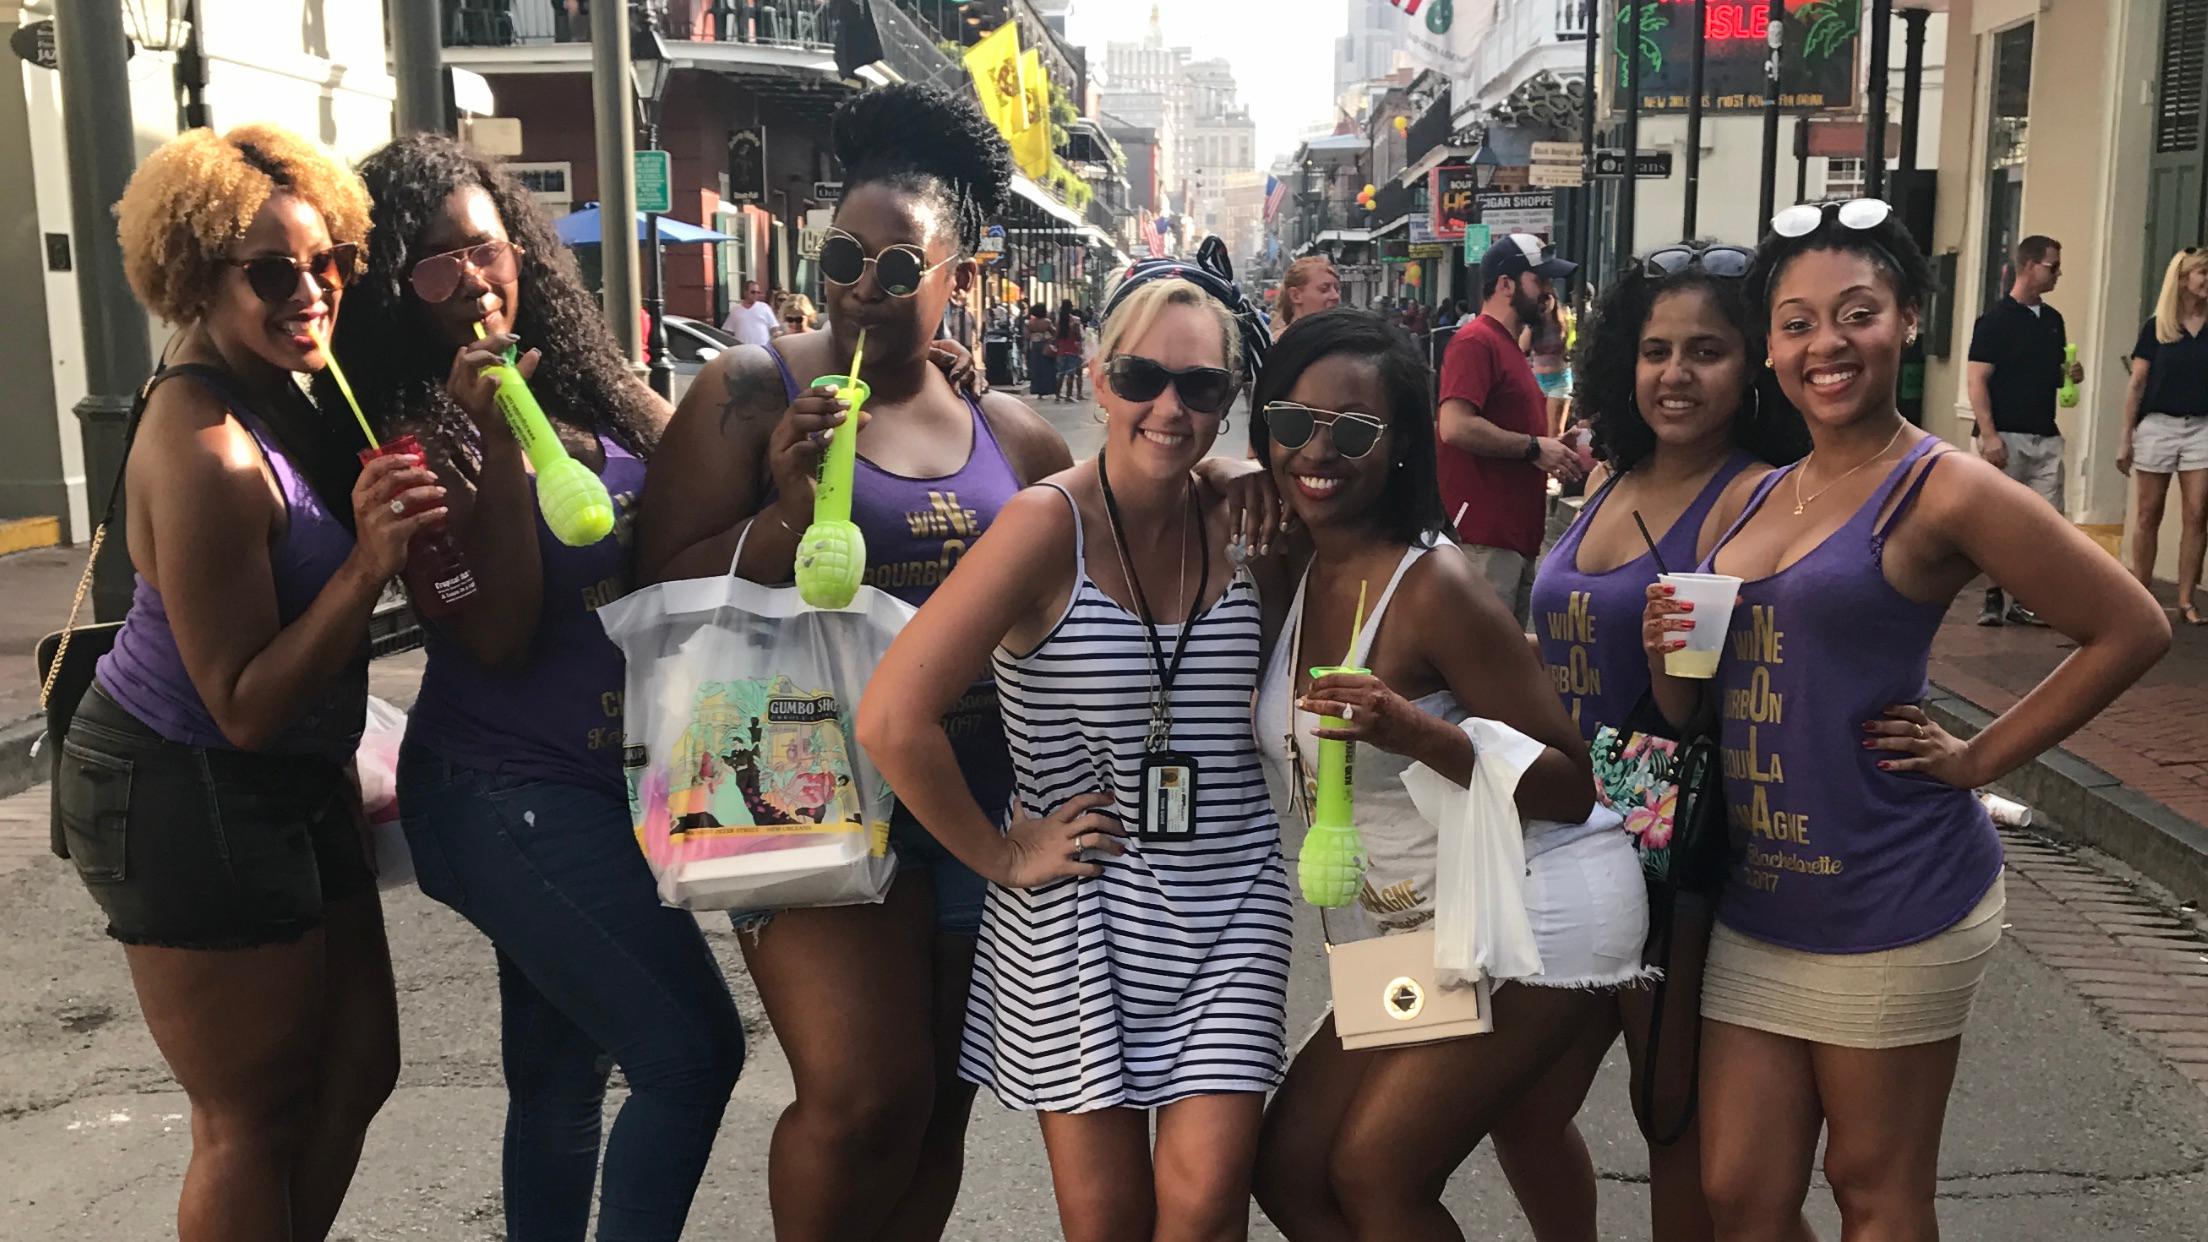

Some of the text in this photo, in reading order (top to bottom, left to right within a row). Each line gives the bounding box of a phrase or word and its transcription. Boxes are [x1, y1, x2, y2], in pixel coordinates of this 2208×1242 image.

[1704, 4, 1770, 39] ISLE
[1513, 194, 1554, 208] SHOPPE
[904, 491, 982, 538] WINE
[1547, 590, 1597, 643] WINE
[1731, 605, 1784, 664] WINE
[770, 701, 815, 716] GUMBO
